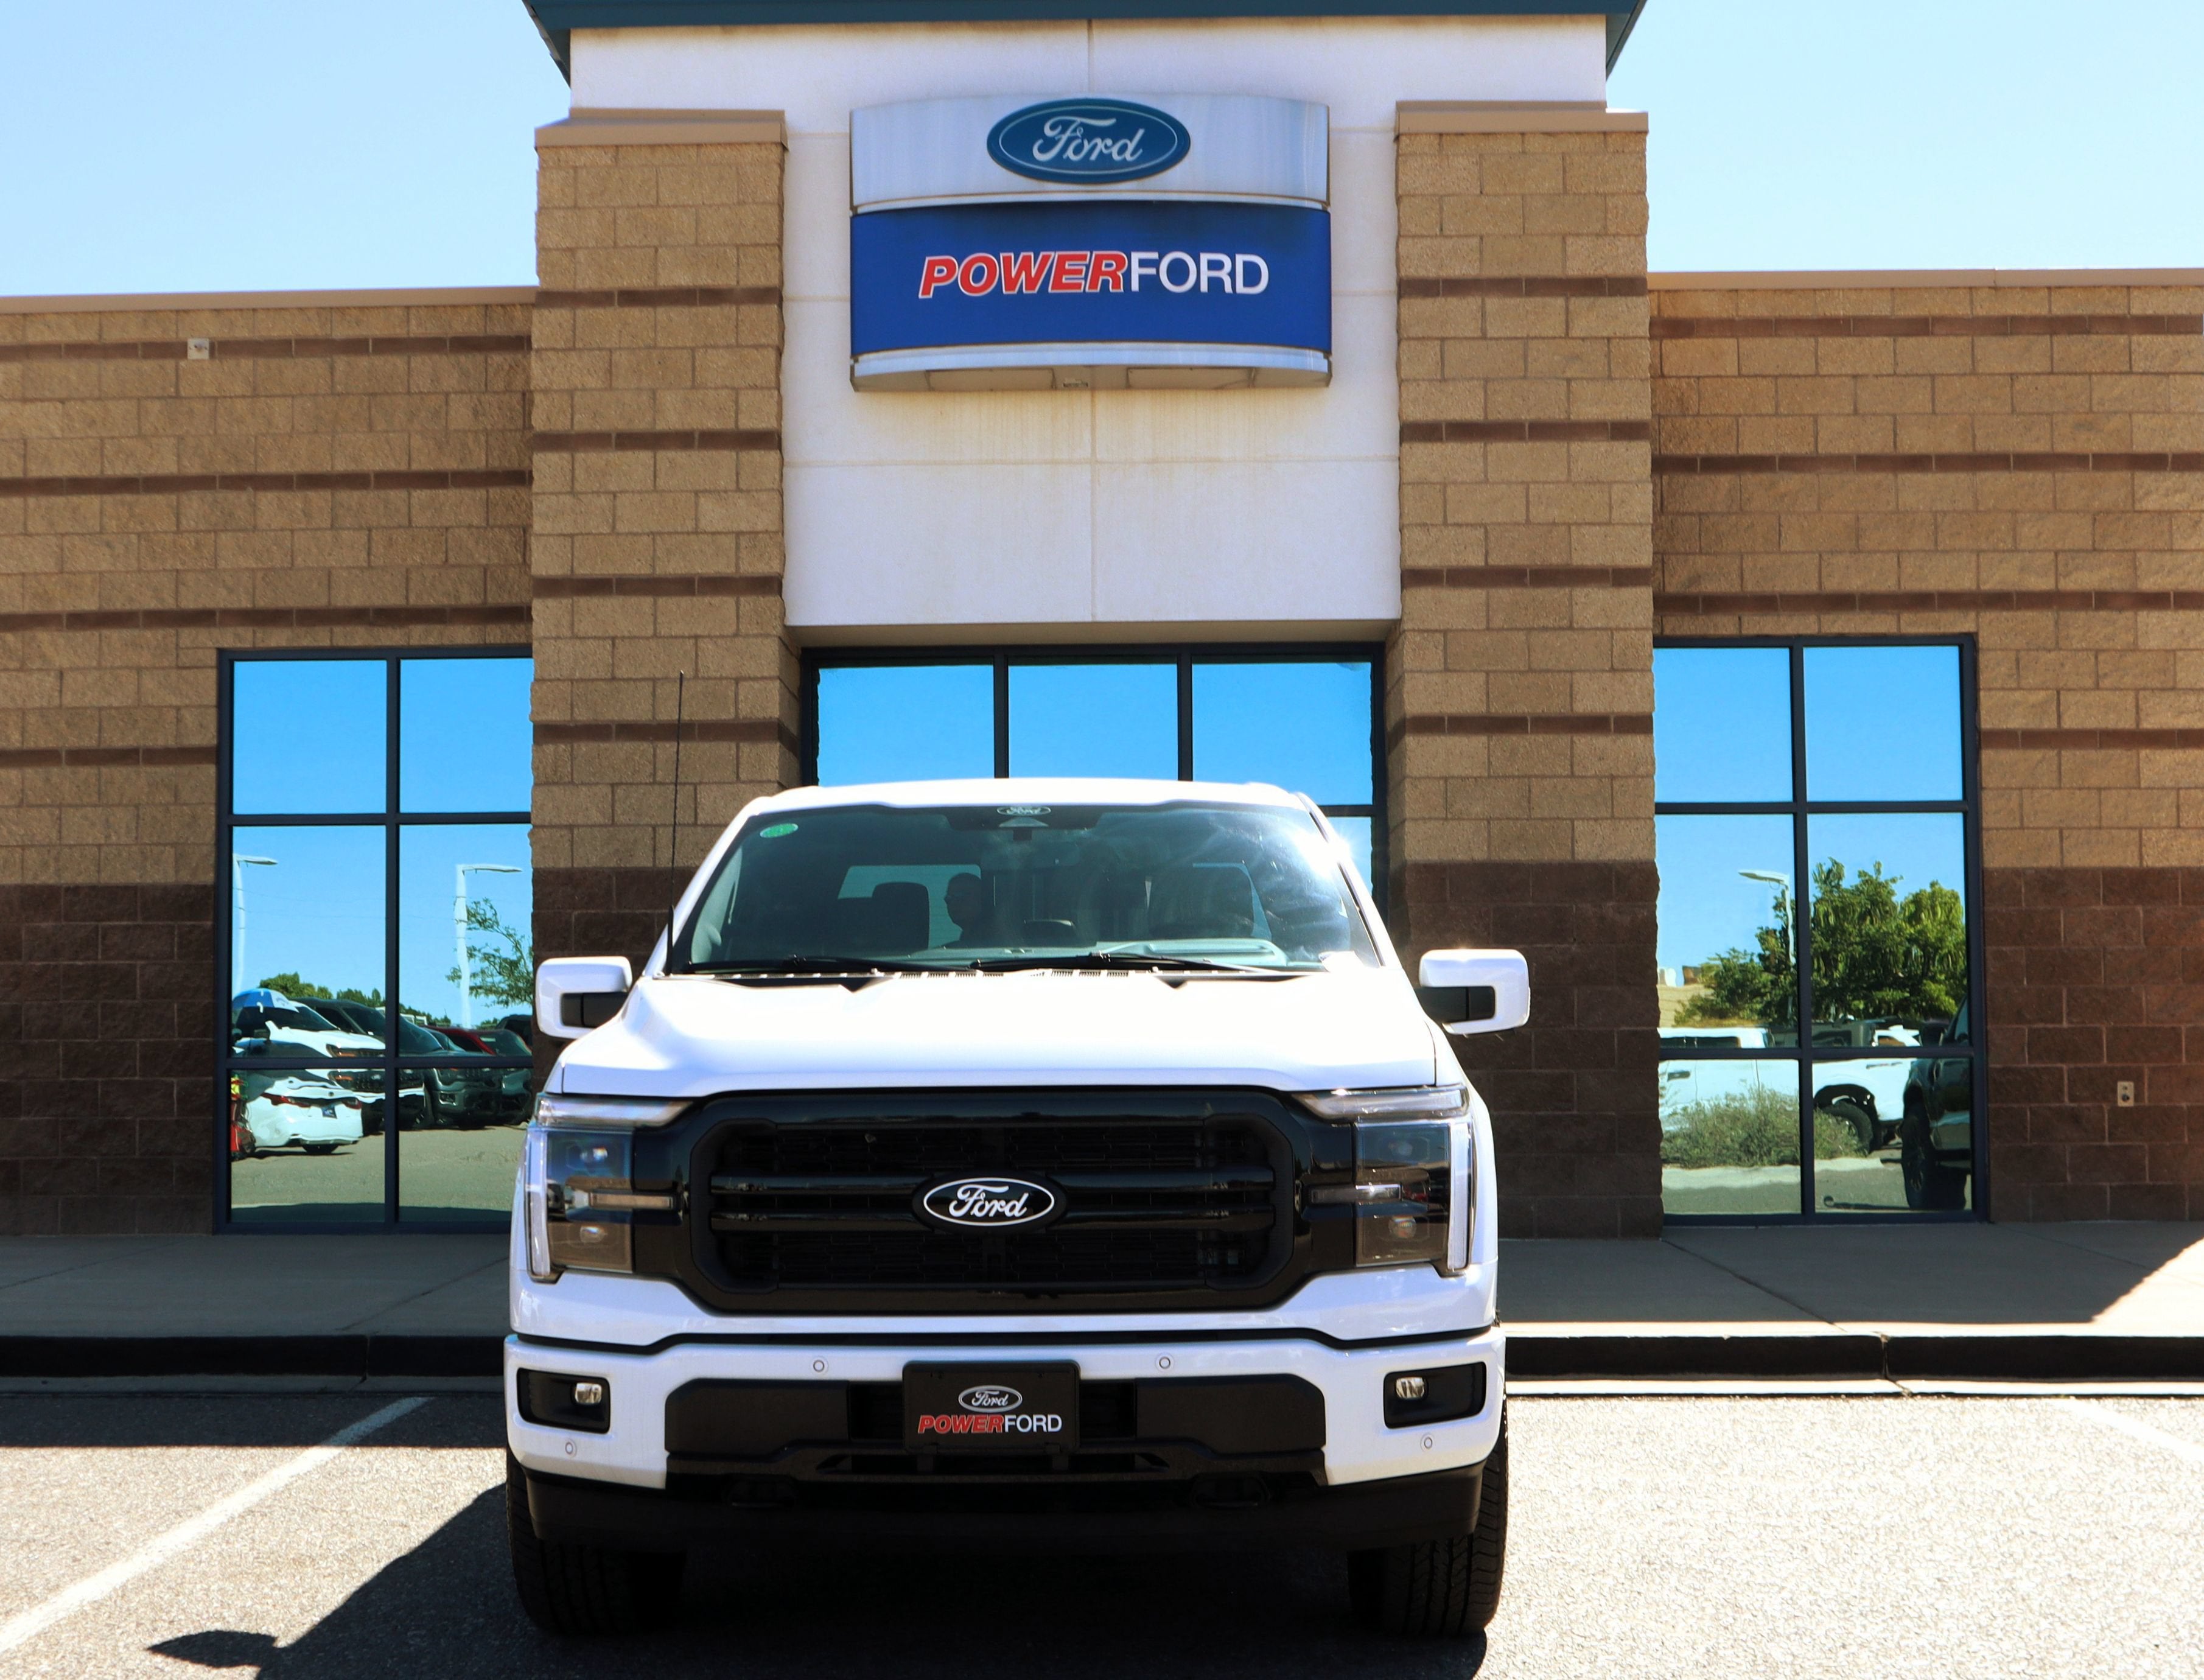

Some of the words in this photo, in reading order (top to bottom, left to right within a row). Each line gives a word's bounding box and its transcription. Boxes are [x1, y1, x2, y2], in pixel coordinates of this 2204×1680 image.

[1032, 116, 1145, 162] Ford
[948, 1184, 1029, 1217] Ford
[971, 1390, 1009, 1407] Ford
